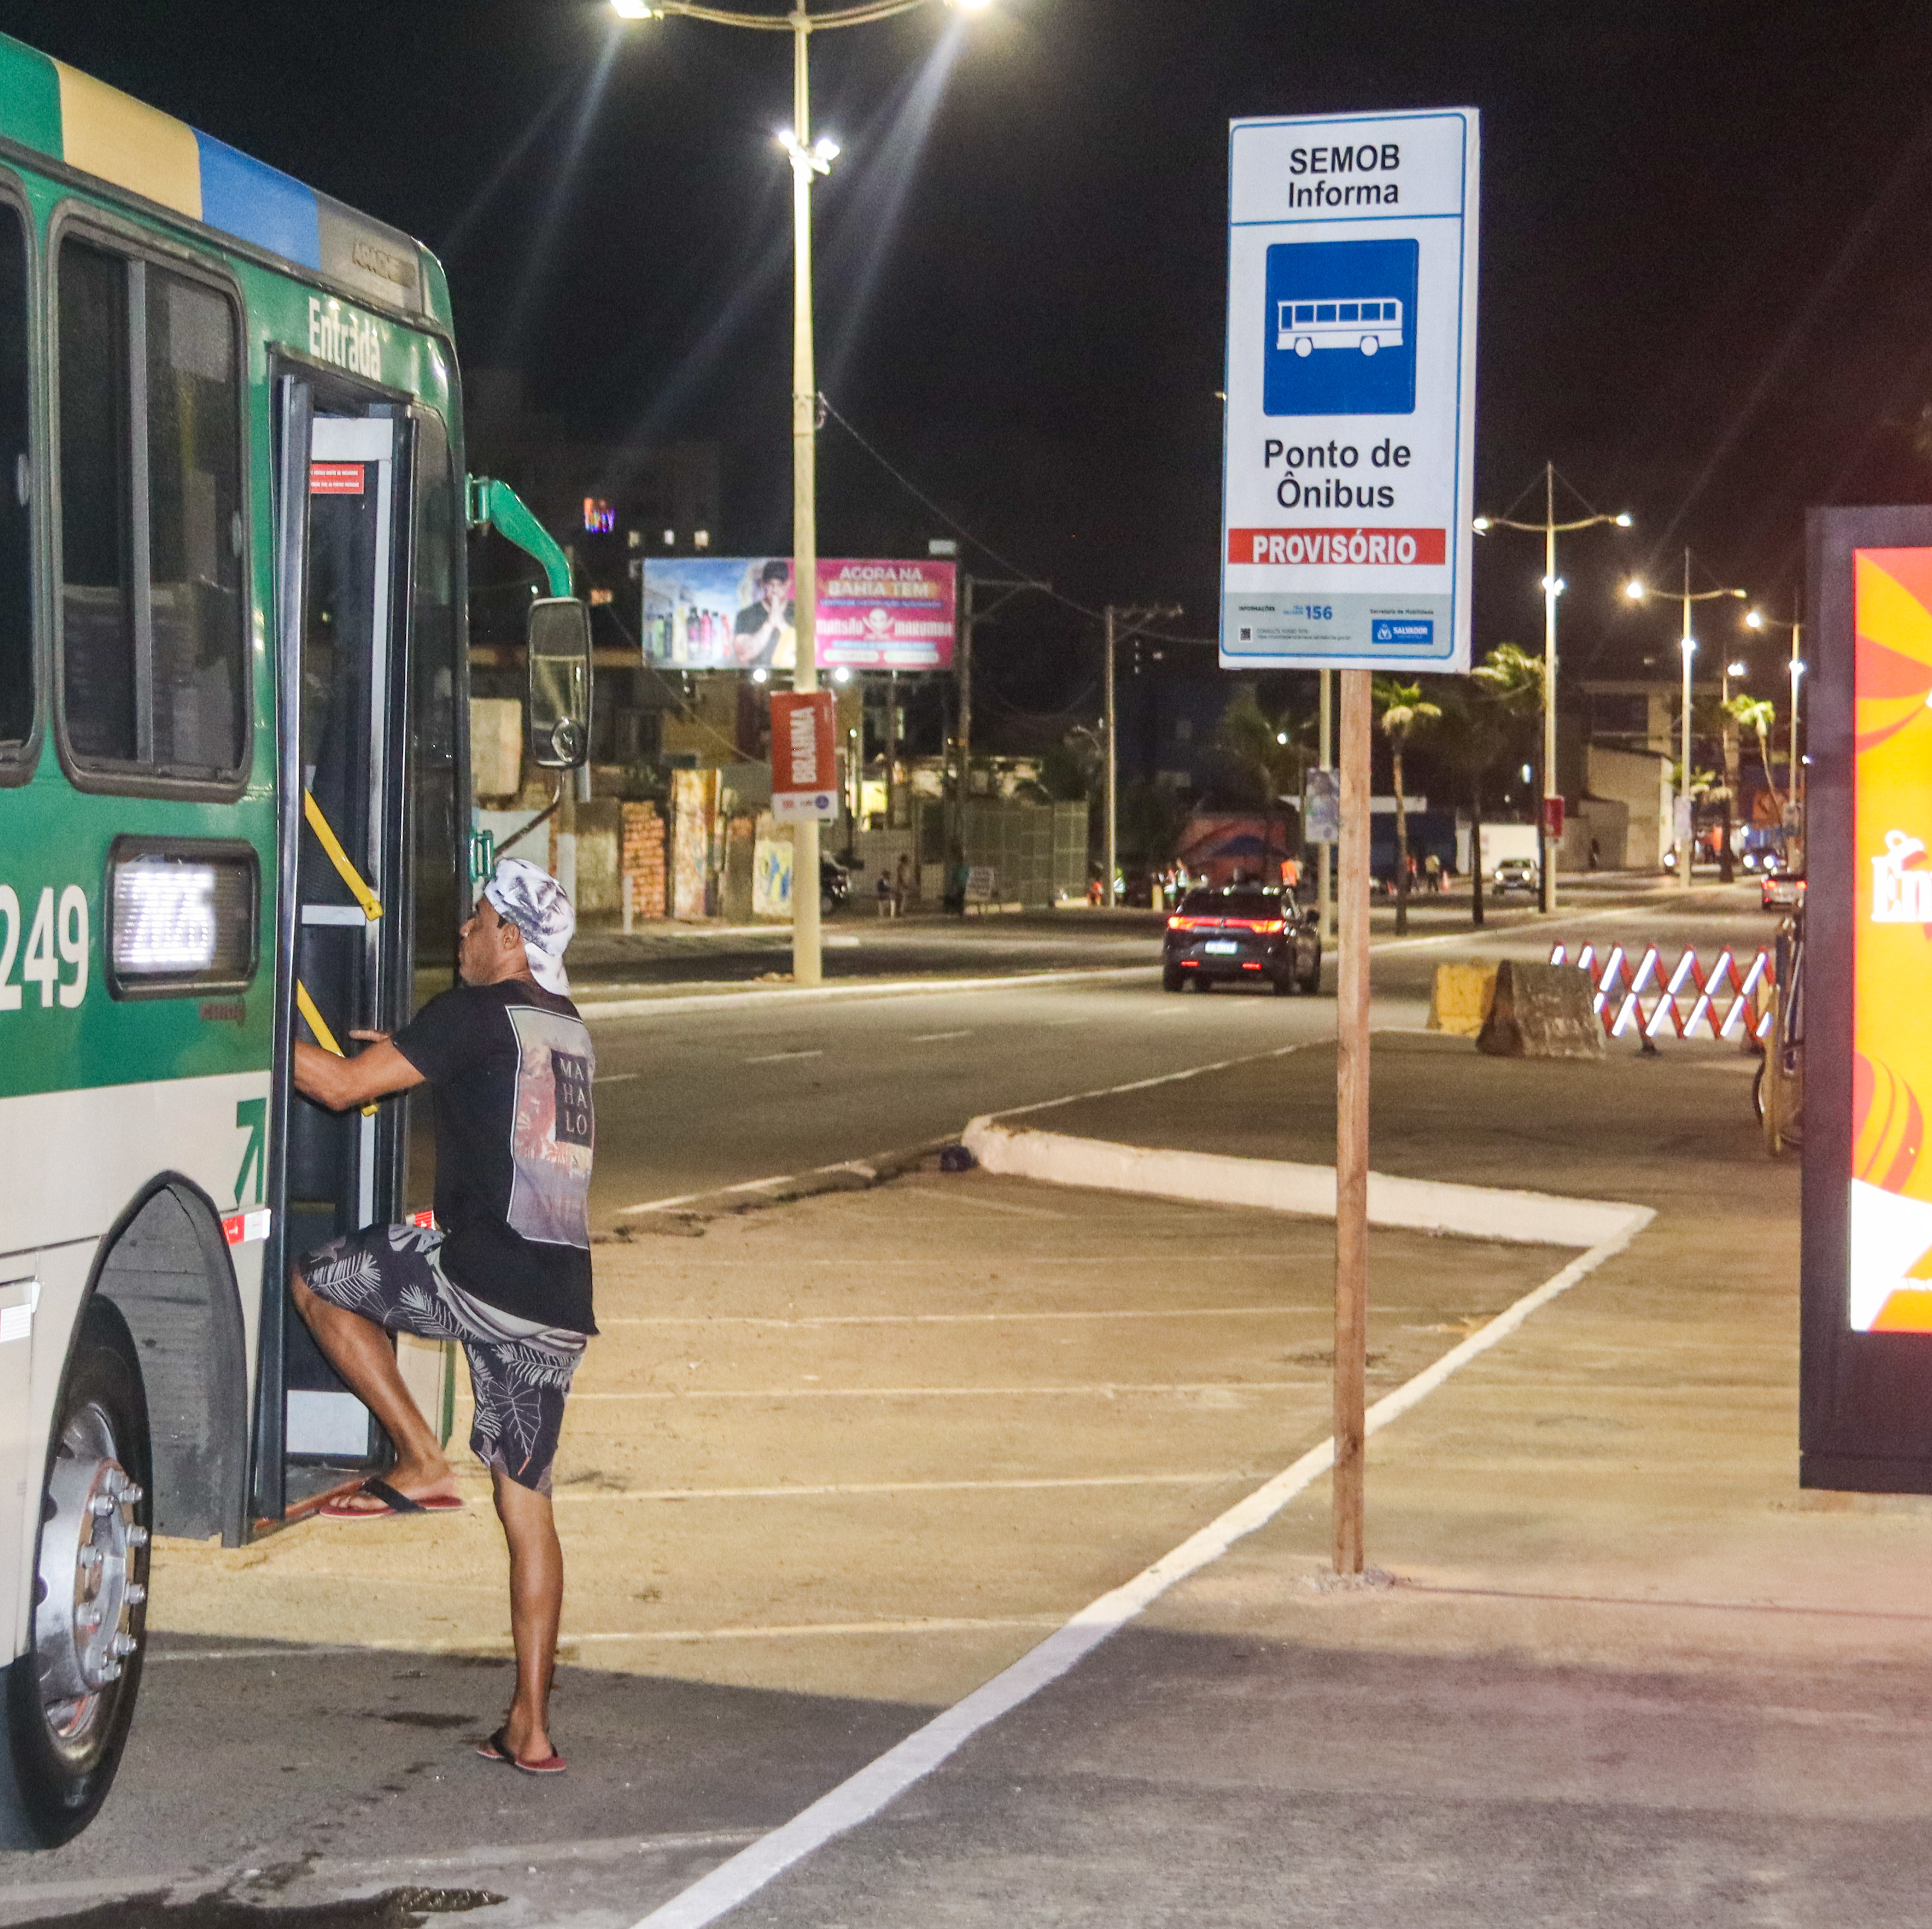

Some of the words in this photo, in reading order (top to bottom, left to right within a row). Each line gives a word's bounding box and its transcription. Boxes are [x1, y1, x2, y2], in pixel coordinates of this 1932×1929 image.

[1290, 144, 1400, 174] SEMOB
[1288, 181, 1399, 208] Informa
[309, 296, 382, 382] Entrada
[1264, 439, 1358, 468] Ponto
[1371, 438, 1411, 467] de
[1277, 471, 1394, 508] Ônibus
[1253, 530, 1417, 564] PROVISÓRIO
[840, 566, 897, 580] AGORA
[899, 568, 922, 581] NA
[828, 580, 886, 597] BAHIA
[892, 581, 930, 598] TEM
[1306, 606, 1332, 620] 156
[1393, 626, 1428, 635] SALVADOR
[790, 707, 817, 784] BRAHMA
